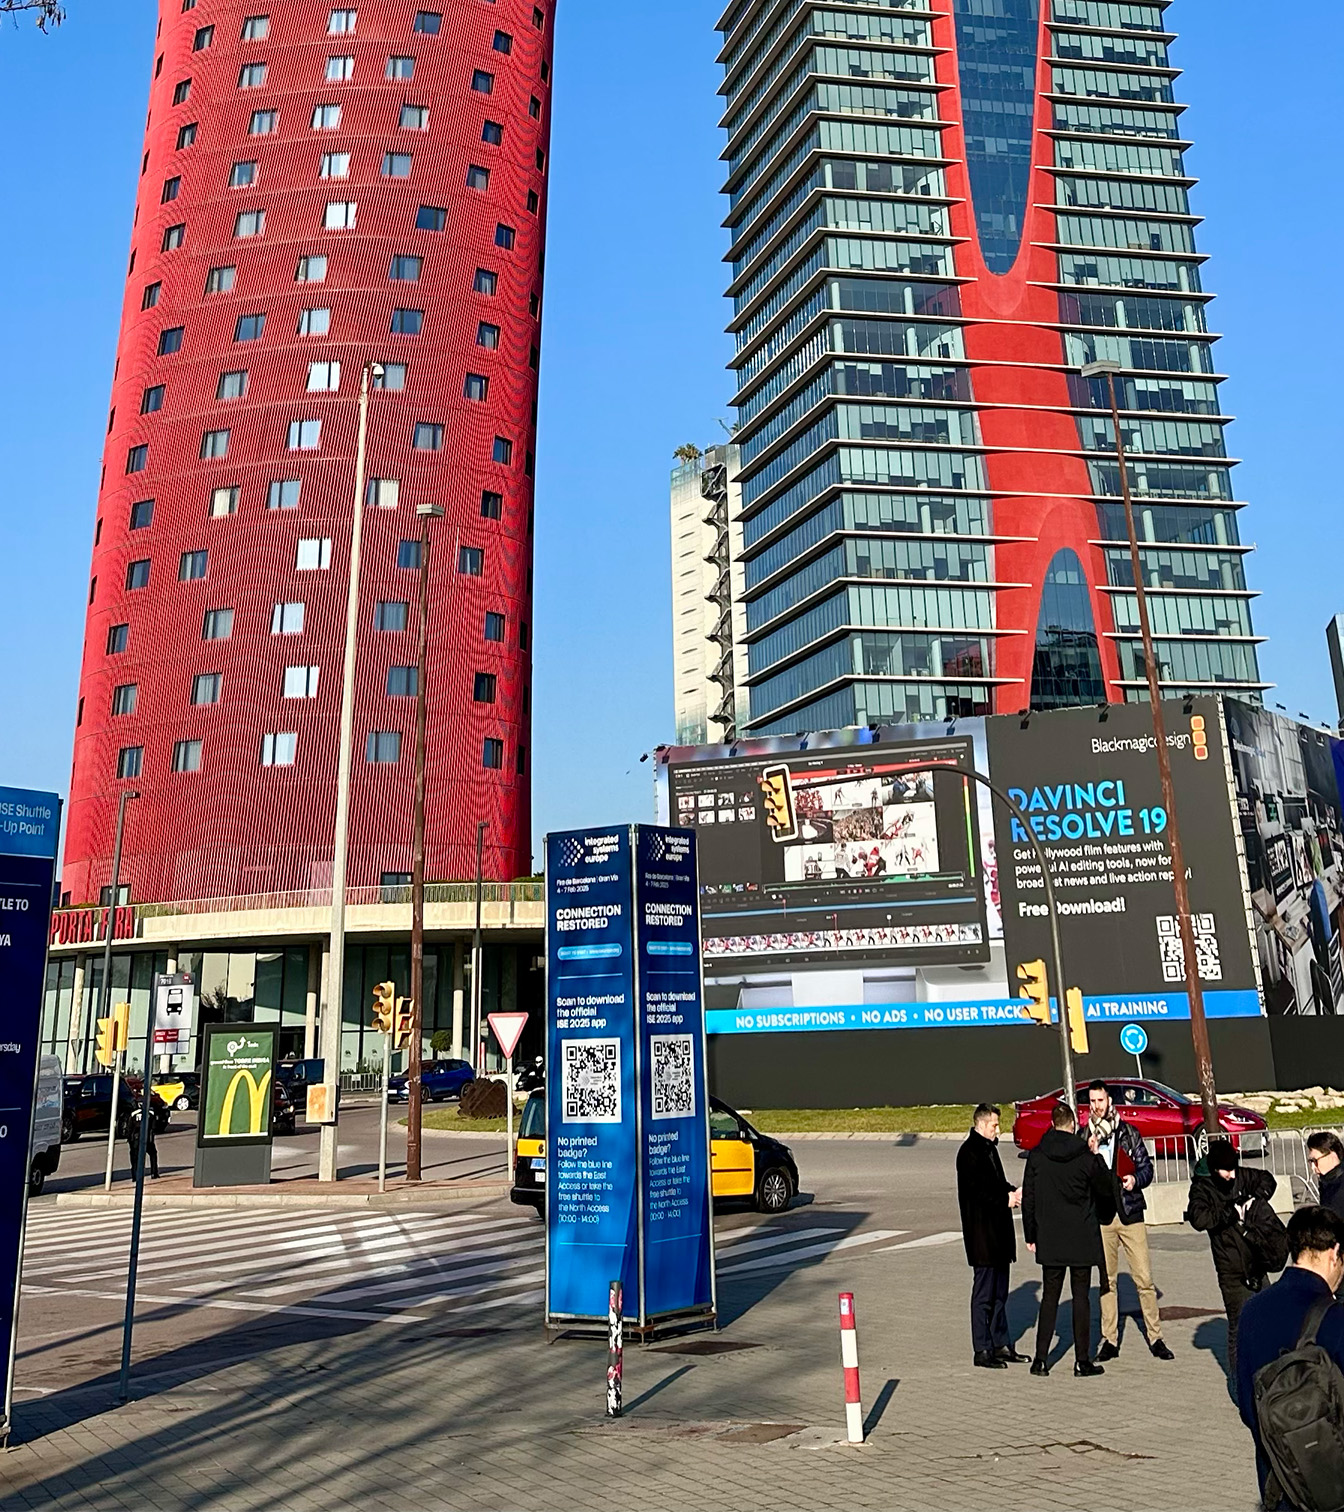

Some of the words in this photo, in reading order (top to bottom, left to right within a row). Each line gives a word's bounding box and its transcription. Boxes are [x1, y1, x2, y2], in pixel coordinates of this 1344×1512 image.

[1008, 780, 1125, 812] DAVINCI
[15, 803, 52, 820] Shuttle
[19, 821, 45, 835] Point
[1011, 809, 1134, 842] RESOLVE
[1139, 806, 1167, 834] 19
[585, 834, 619, 846] integrated
[1014, 848, 1031, 860] Get
[1084, 845, 1102, 856] film
[1103, 843, 1141, 856] features
[1142, 839, 1164, 852] with
[585, 854, 608, 863] europe
[1058, 861, 1069, 872] AI
[1071, 859, 1104, 874] editing
[1106, 857, 1134, 870] tools,
[1135, 858, 1156, 868] now
[1158, 854, 1172, 865] for
[1064, 874, 1088, 887] news
[1090, 873, 1108, 885] and
[1109, 871, 1126, 883] live
[1127, 869, 1157, 882] action
[15, 898, 29, 911] TO
[645, 903, 692, 915] CONNECTION
[1018, 902, 1049, 917] Free
[556, 904, 621, 920] CONNECTION
[50, 909, 93, 945] PORTA
[100, 907, 134, 941] FRA
[557, 918, 608, 931] RESTORED
[646, 915, 683, 926] RESTORED
[557, 997, 576, 1007] Scan
[577, 996, 586, 1006] to
[586, 994, 624, 1005] download
[646, 992, 661, 1001] Scan
[662, 992, 667, 1001] to
[668, 991, 696, 1001] download
[557, 1008, 569, 1017] the
[570, 1006, 597, 1016] official
[647, 1003, 656, 1012] the
[657, 1003, 676, 1012] official
[735, 1015, 754, 1029] NO
[756, 1011, 845, 1028] SUBSCRIPTIONS
[861, 1010, 881, 1024] NO
[883, 1010, 907, 1023] ADS
[924, 1008, 944, 1022] NO
[946, 1007, 979, 1021] USER
[981, 1005, 1022, 1020] TRACK
[1087, 1003, 1100, 1017] AI
[1102, 1001, 1168, 1015] TRAINING
[557, 1019, 568, 1028] ISE
[570, 1018, 590, 1028] 2025
[591, 1018, 606, 1029] app
[557, 1137, 568, 1146] No
[570, 1136, 597, 1147] printed
[649, 1134, 656, 1143] No
[658, 1131, 678, 1143] printed
[558, 1148, 588, 1159] badge?
